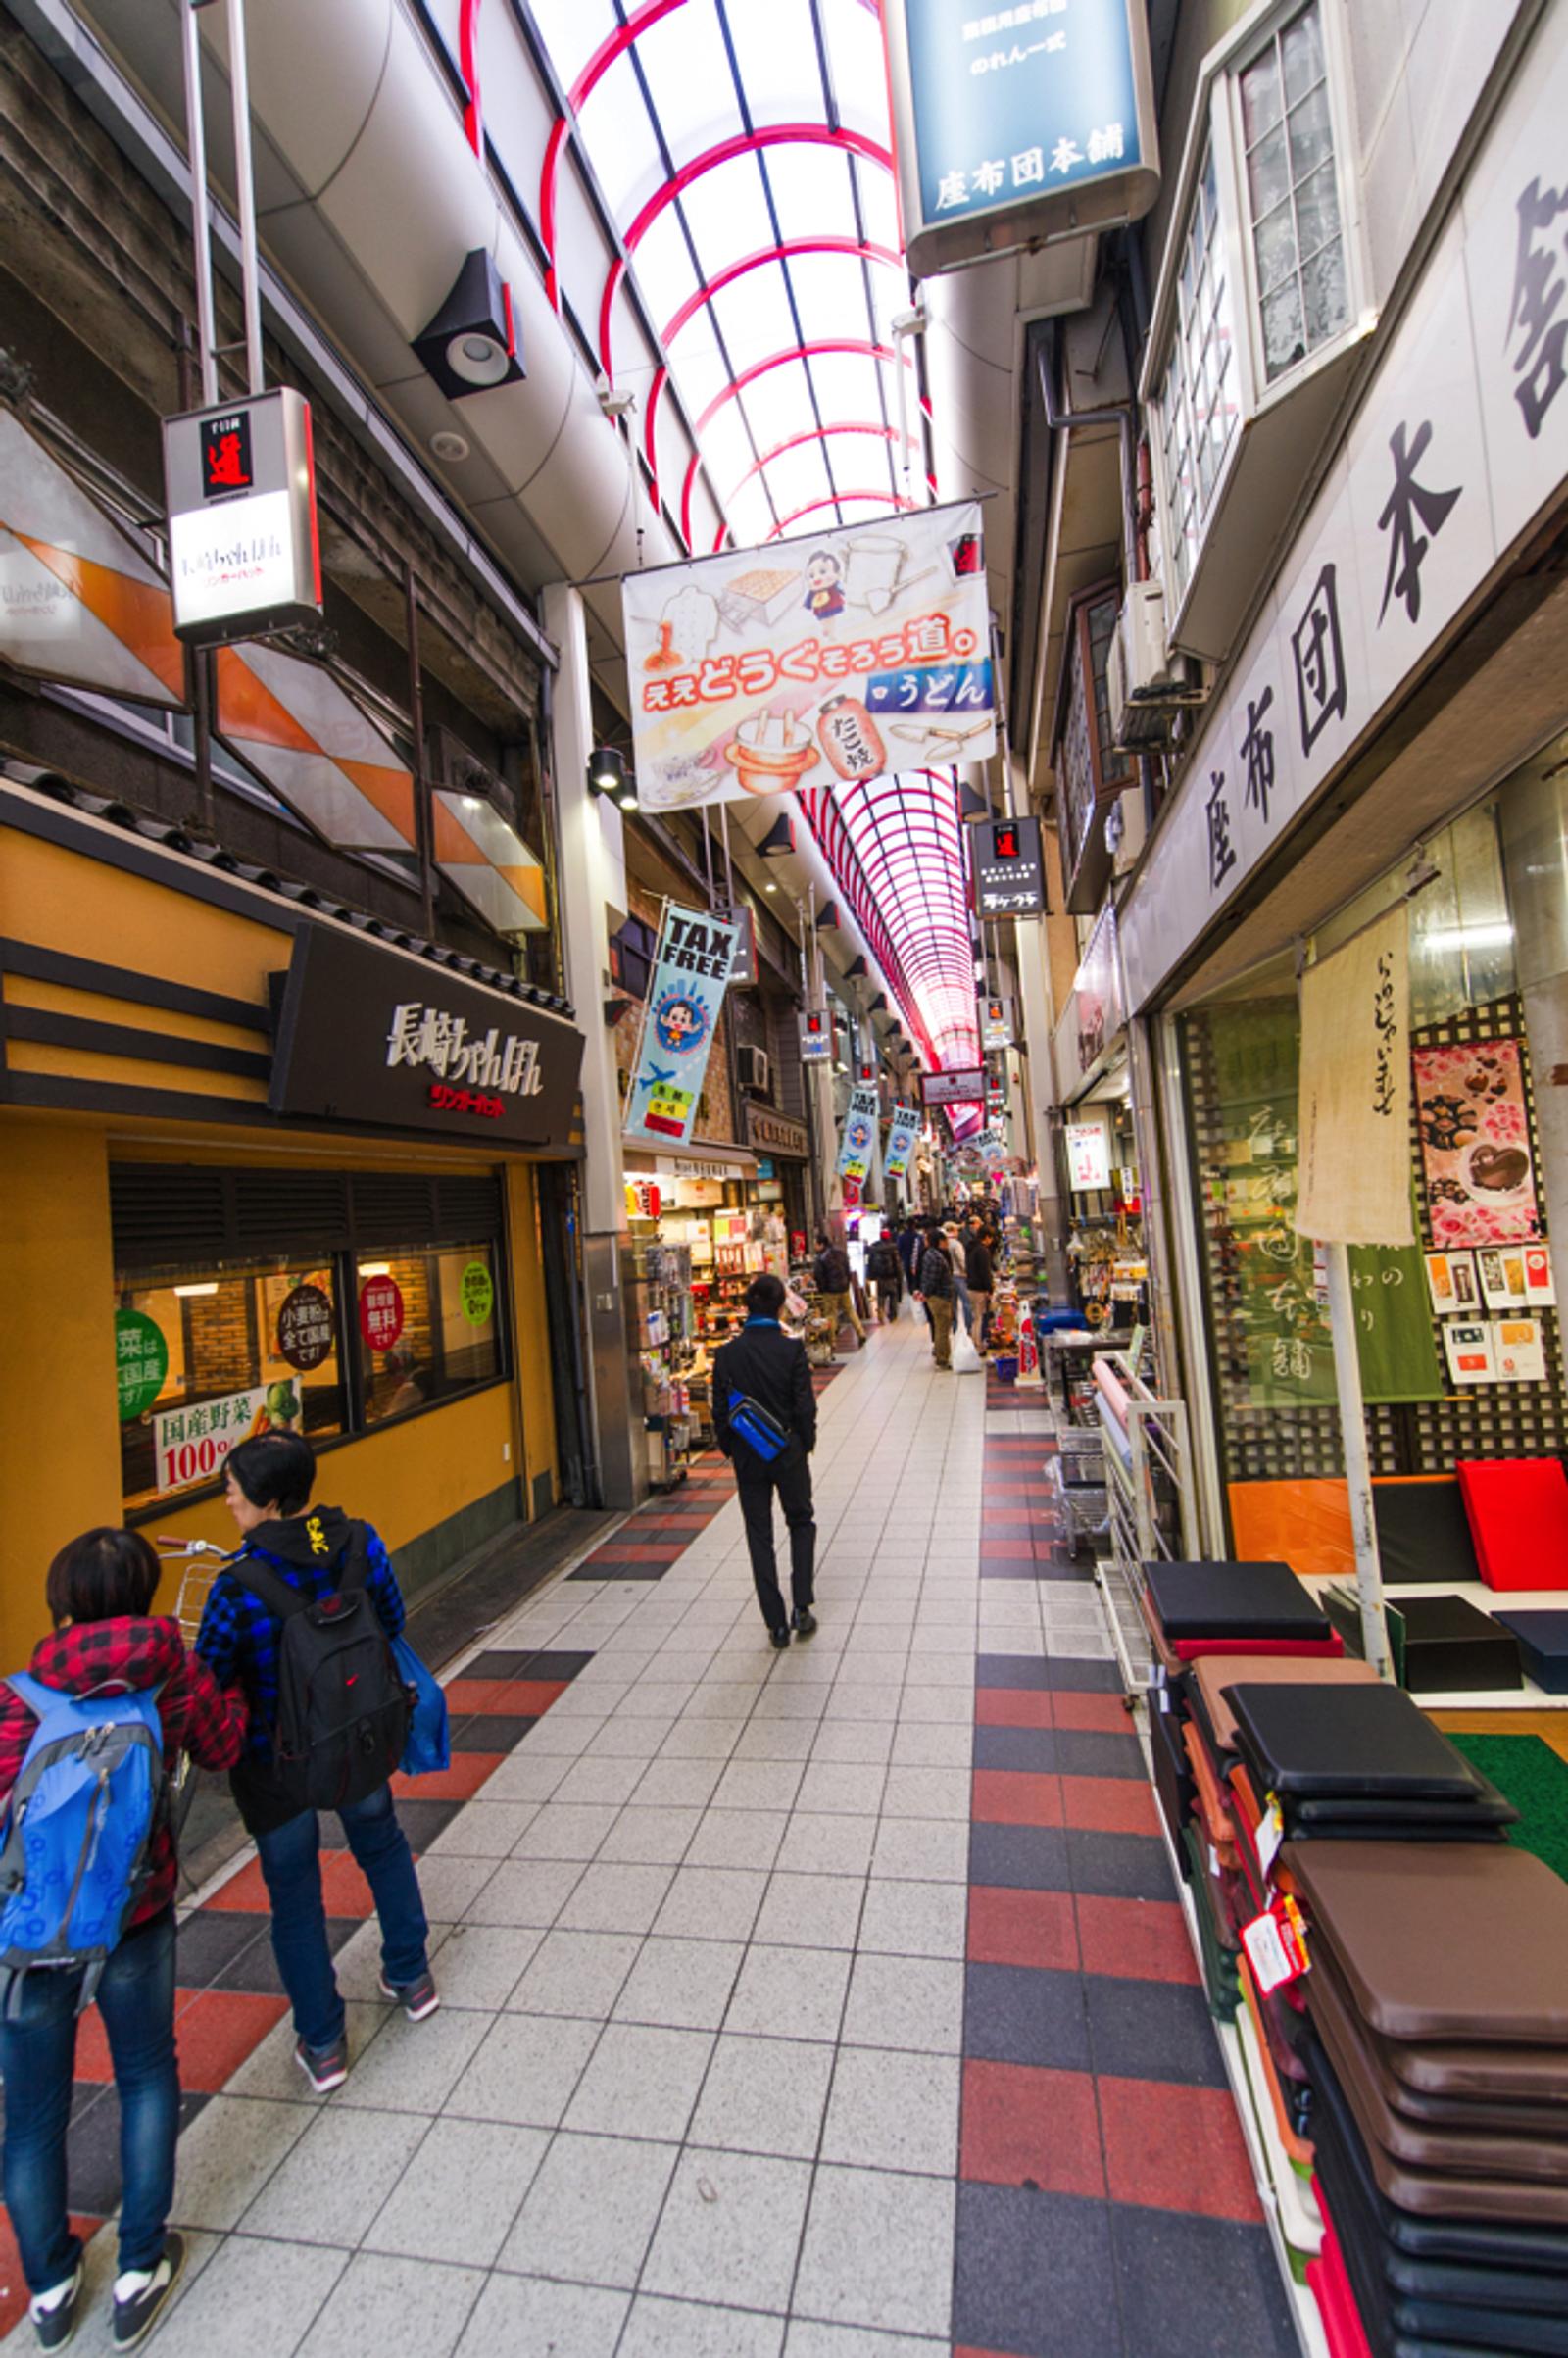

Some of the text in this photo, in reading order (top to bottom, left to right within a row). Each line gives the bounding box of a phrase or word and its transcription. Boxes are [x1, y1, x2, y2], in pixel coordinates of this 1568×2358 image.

[934, 123, 1125, 212] 座布団本舗
[643, 613, 977, 713] ええどうぐそろう道。
[898, 670, 986, 707] うどん
[832, 716, 875, 771] たこ焼
[662, 944, 728, 981] FREE
[668, 915, 733, 960] TAX
[162, 1396, 252, 1448] 国産野菜
